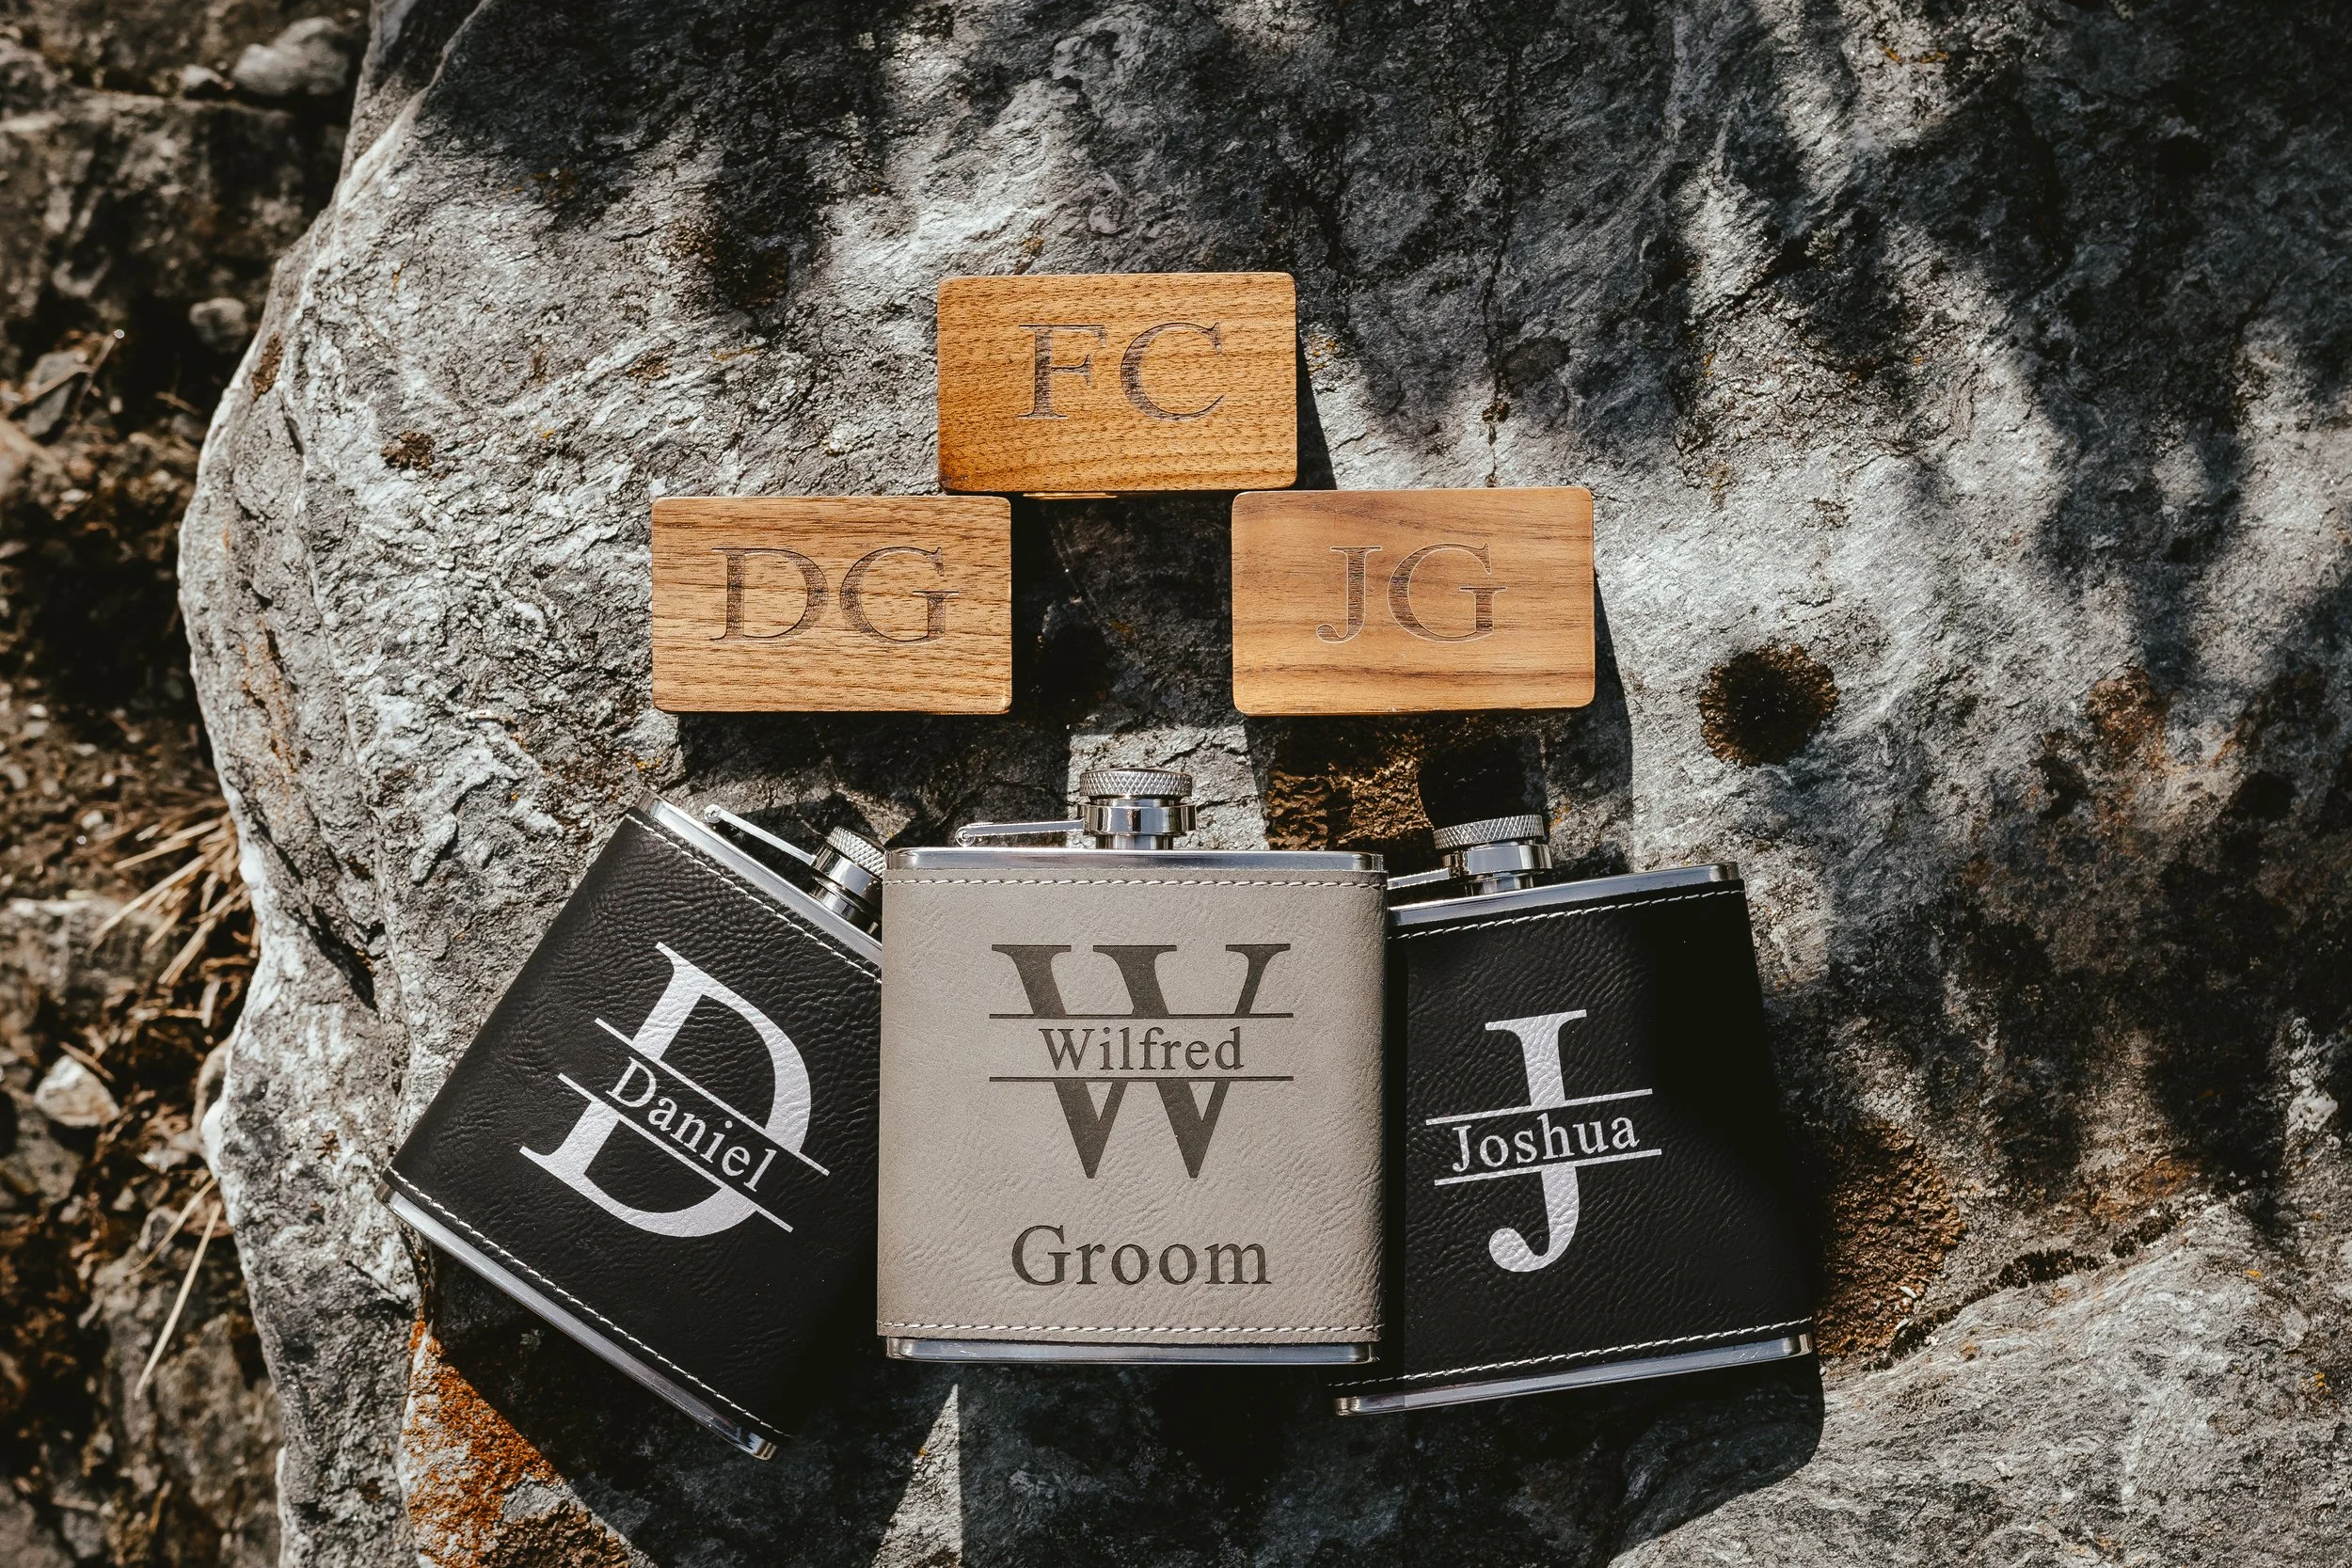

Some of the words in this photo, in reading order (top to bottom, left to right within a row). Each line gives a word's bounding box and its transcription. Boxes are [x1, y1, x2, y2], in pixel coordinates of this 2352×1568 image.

[1018, 322, 1226, 421] FC
[710, 546, 960, 644] DG
[1316, 543, 1507, 643] JG
[519, 942, 812, 1238] D
[991, 943, 1292, 1180] W
[1038, 1026, 1245, 1071] Wilfred
[605, 1057, 779, 1194] Daniel
[1451, 1112, 1641, 1174] Joshua
[1485, 1009, 1587, 1273] J
[1011, 1225, 1272, 1286] Groom
